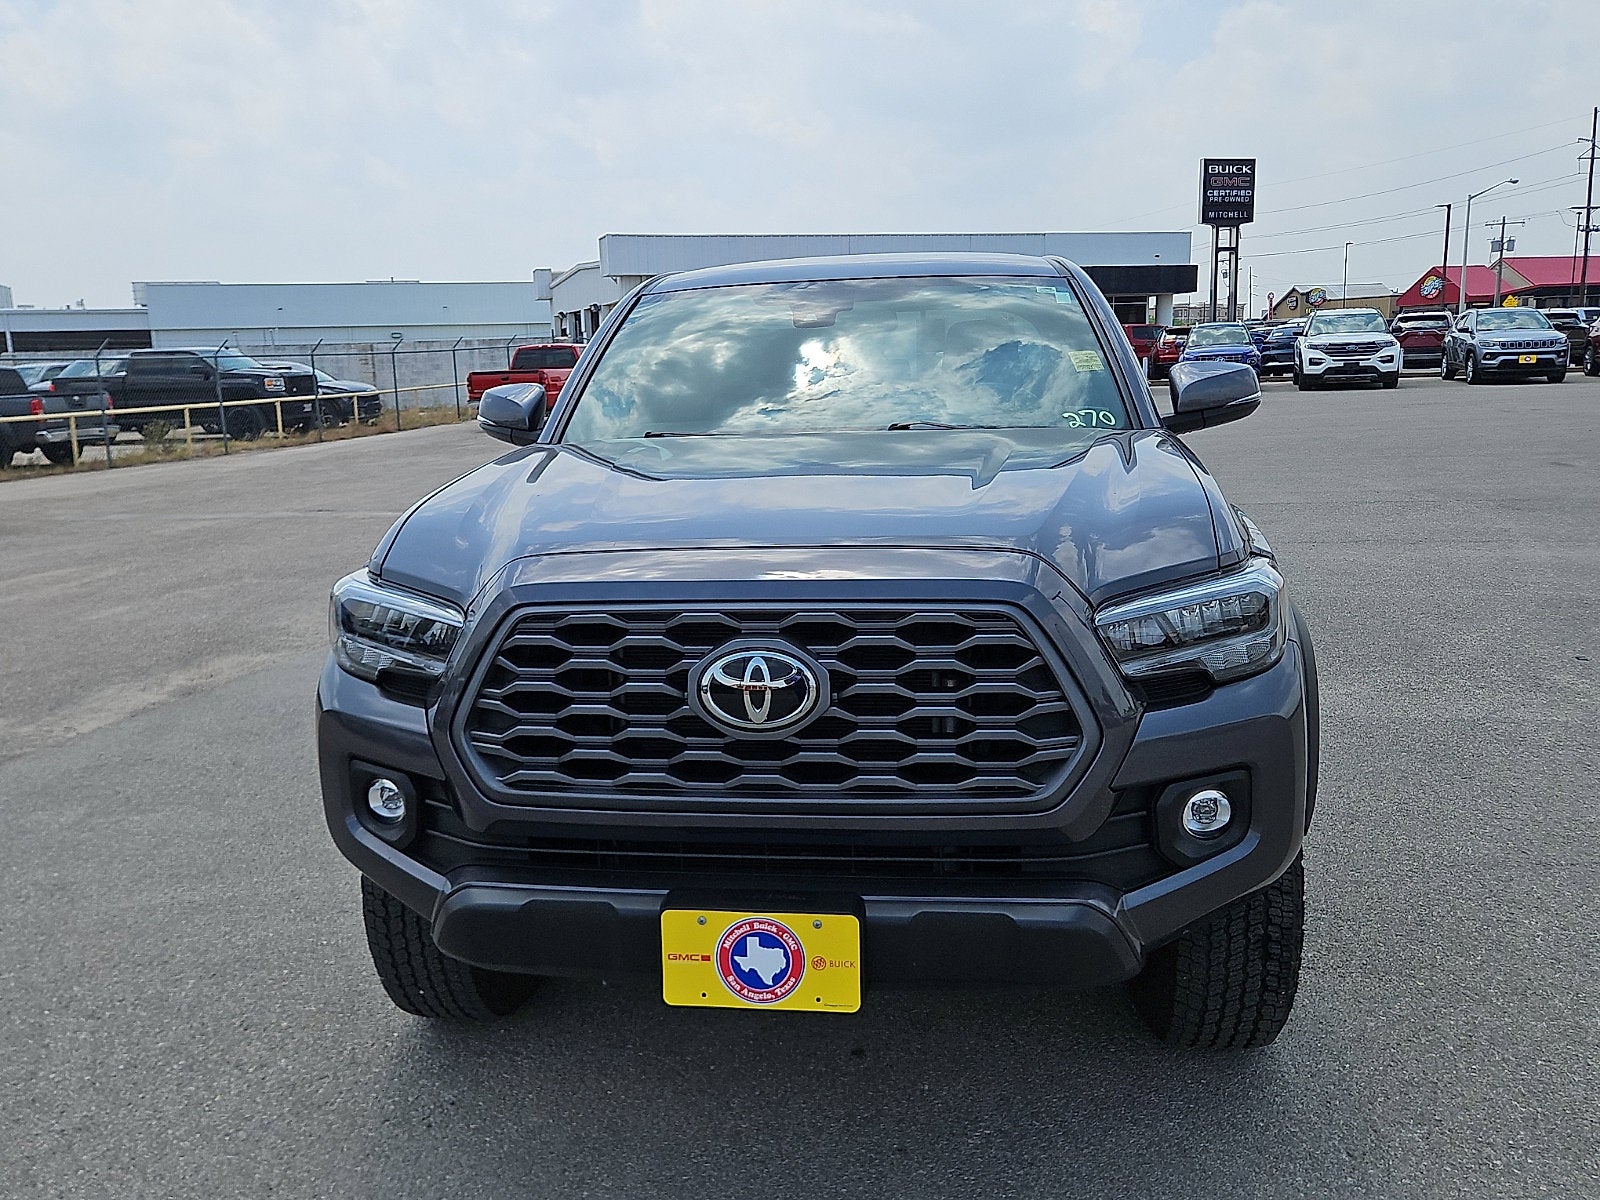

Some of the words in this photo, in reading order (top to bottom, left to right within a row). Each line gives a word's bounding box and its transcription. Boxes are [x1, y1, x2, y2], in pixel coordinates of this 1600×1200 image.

[1208, 165, 1253, 174] BUICK
[1210, 176, 1250, 187] GMC
[1208, 211, 1249, 219] MITCHELL
[1062, 409, 1116, 428] 270
[723, 923, 751, 950] Mitchell
[753, 921, 779, 933] Buick
[782, 932, 798, 951] GMC
[667, 953, 700, 962] GMC
[829, 960, 856, 969] BUICK
[726, 974, 741, 991] San
[740, 987, 776, 1001] Angelo,
[774, 975, 796, 996] Texas
